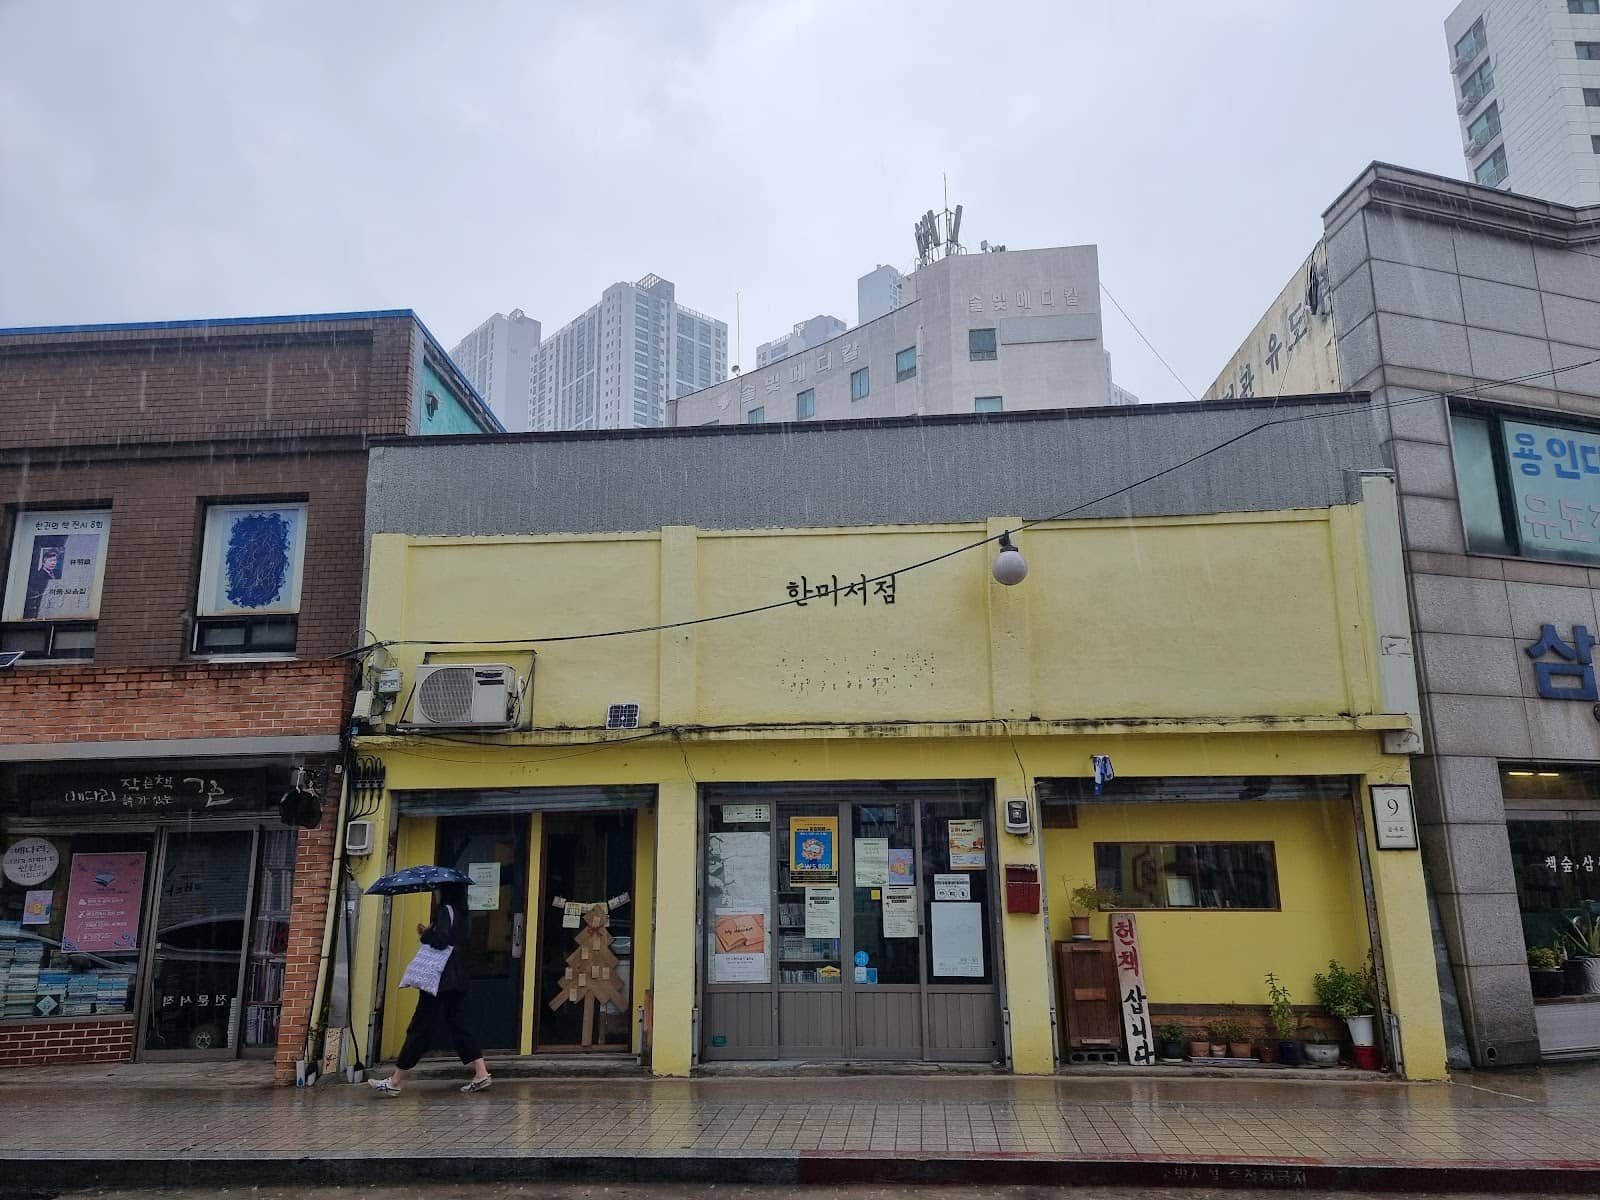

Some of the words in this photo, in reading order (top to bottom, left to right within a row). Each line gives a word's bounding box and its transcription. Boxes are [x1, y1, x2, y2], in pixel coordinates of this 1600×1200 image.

[786, 573, 895, 607] 한미서점
[65, 789, 116, 802] 배다리
[183, 777, 234, 808] 길
[1387, 798, 1399, 816] 9
[1114, 918, 1139, 977] 헌책
[1124, 984, 1155, 1065] 삽니다
